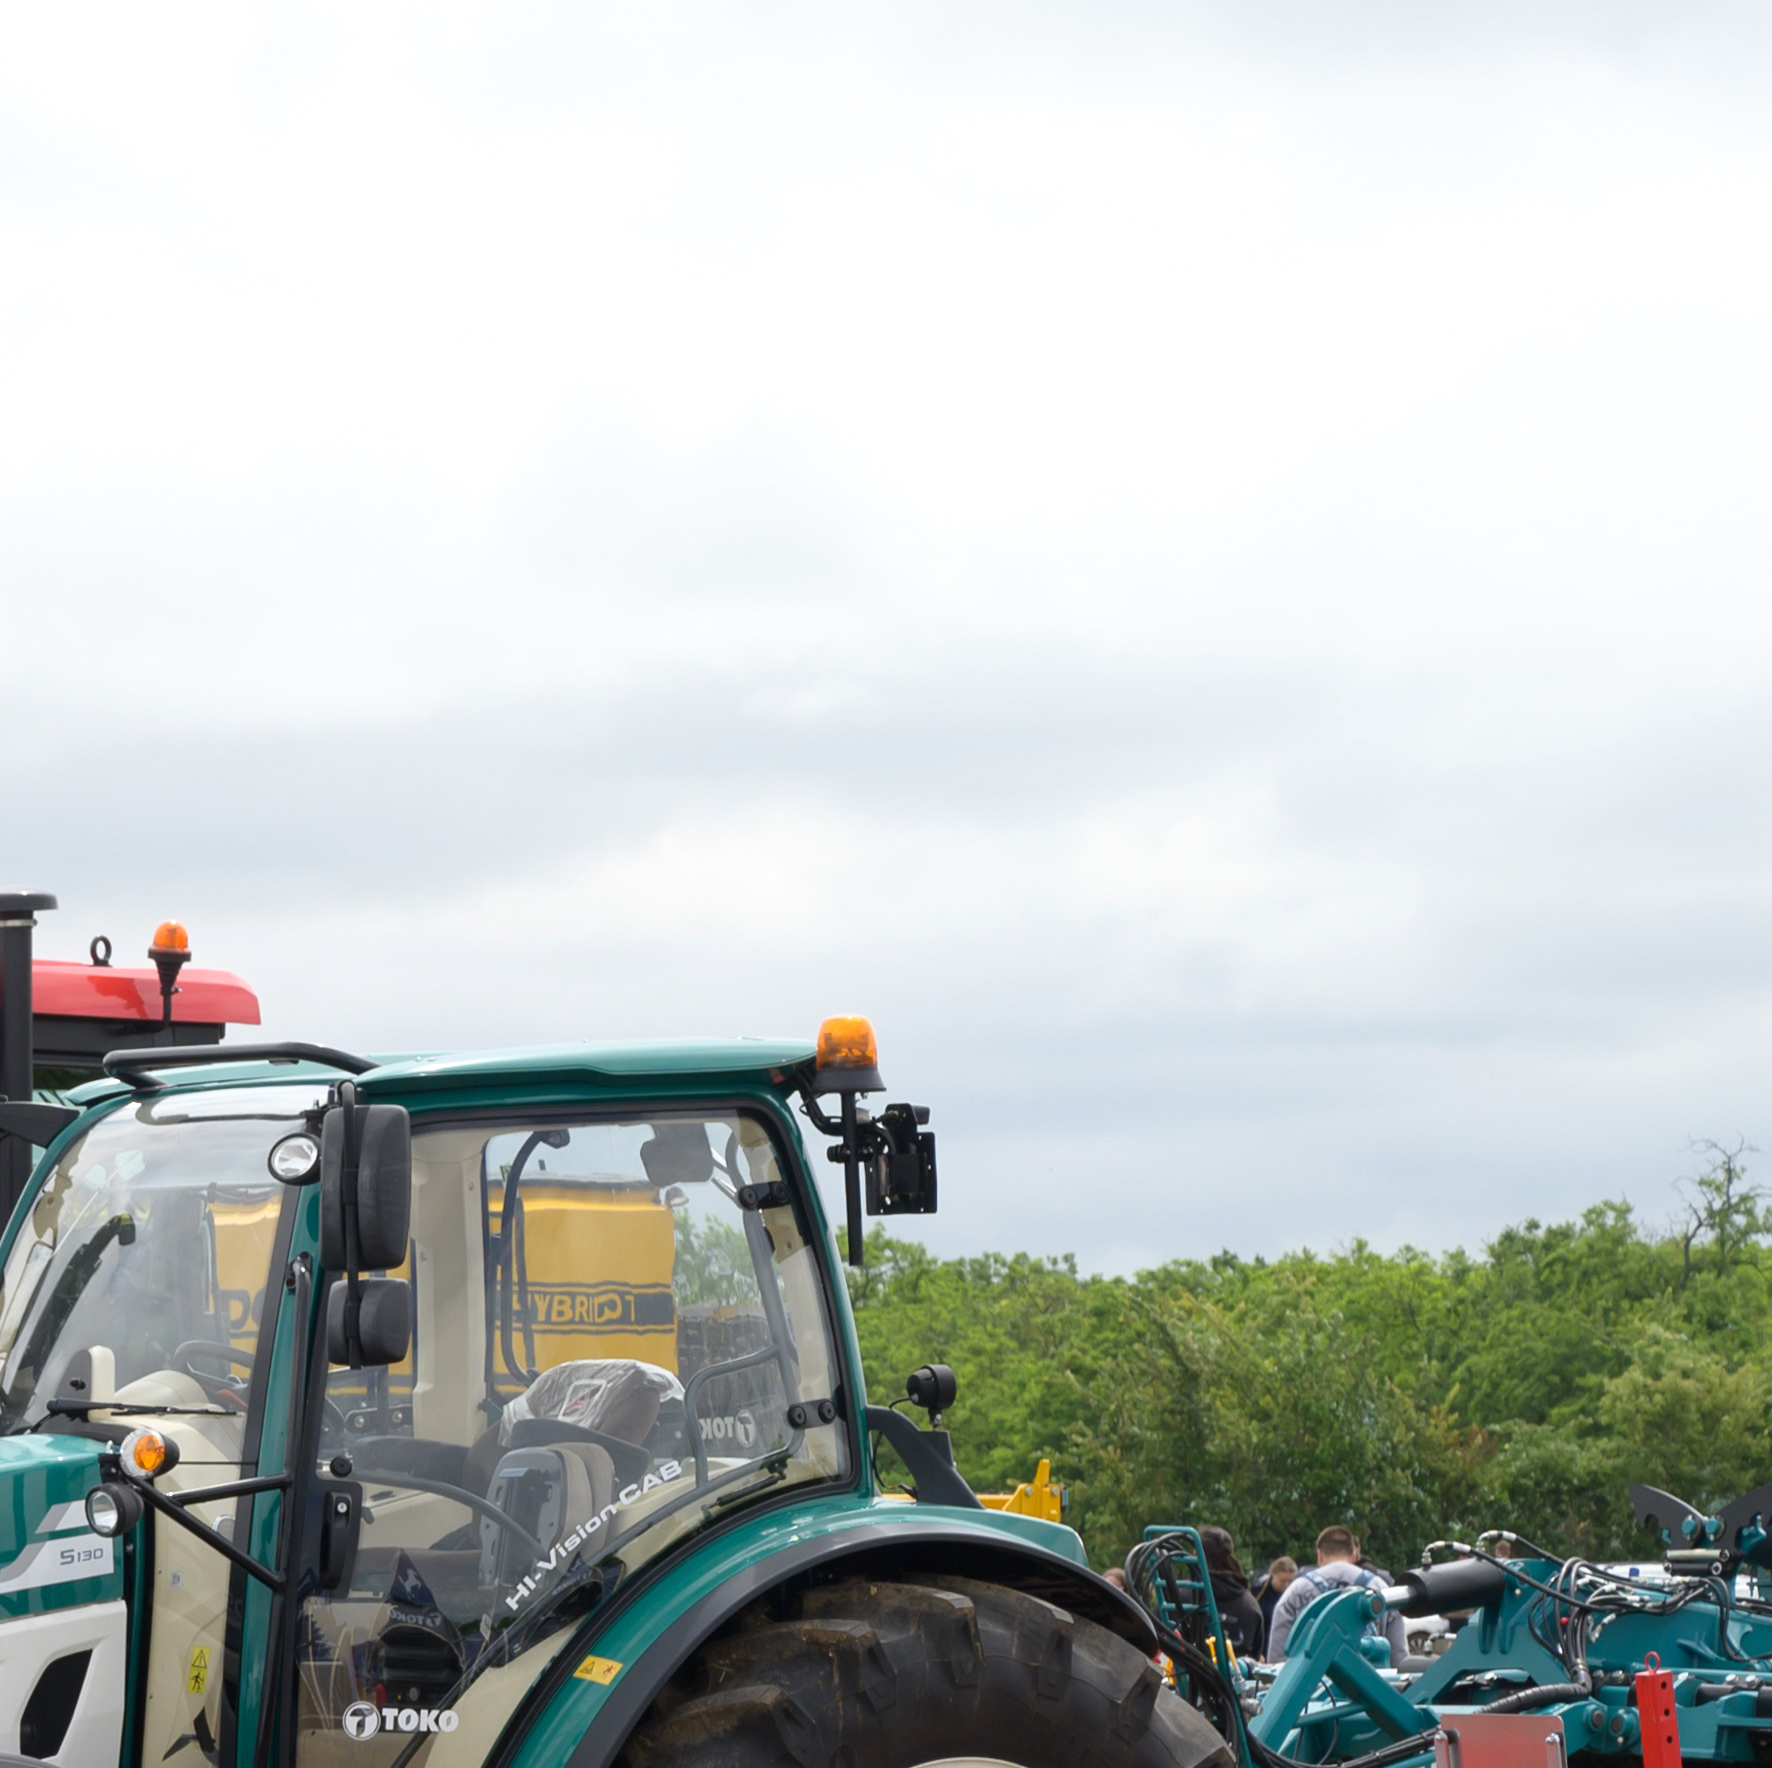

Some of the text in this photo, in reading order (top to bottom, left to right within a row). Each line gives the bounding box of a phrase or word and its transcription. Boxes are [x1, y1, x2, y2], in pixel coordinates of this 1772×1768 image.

[505, 1459, 683, 1612] HI-Vision CAB
[59, 1547, 104, 1566] S130
[381, 1707, 460, 1733] TOKO
